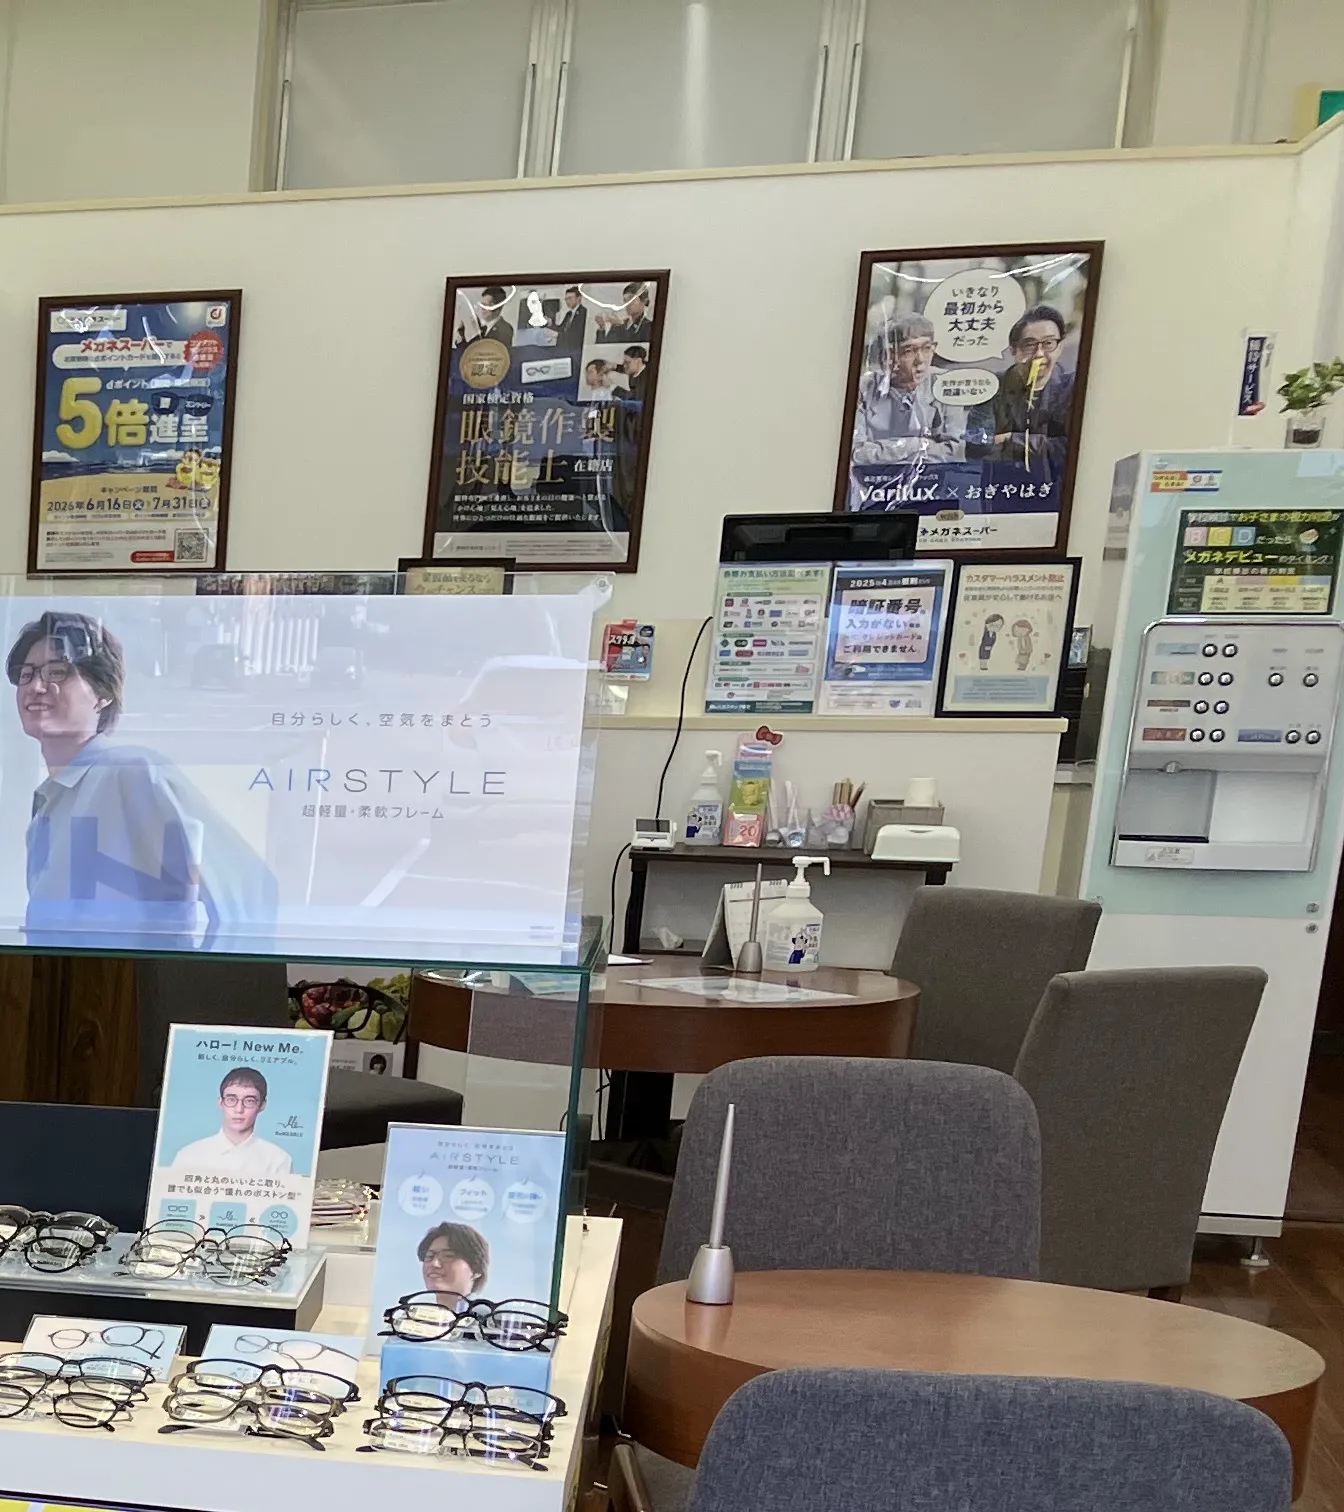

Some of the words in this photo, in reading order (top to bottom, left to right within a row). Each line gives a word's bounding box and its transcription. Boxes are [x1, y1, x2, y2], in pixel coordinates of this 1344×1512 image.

[952, 286, 999, 298] いきなり
[944, 300, 1004, 316] 最初から
[948, 317, 996, 332] 大丈夫
[953, 335, 989, 347] だった
[456, 449, 569, 485] 技能士
[965, 482, 1053, 499] おぎやはぎ
[271, 712, 492, 728] 自分らしく、空気をまとう
[248, 768, 506, 795] AIRSTYLE
[302, 804, 444, 820] 超軽量・柔軟フレーム
[243, 1041, 274, 1054] New
